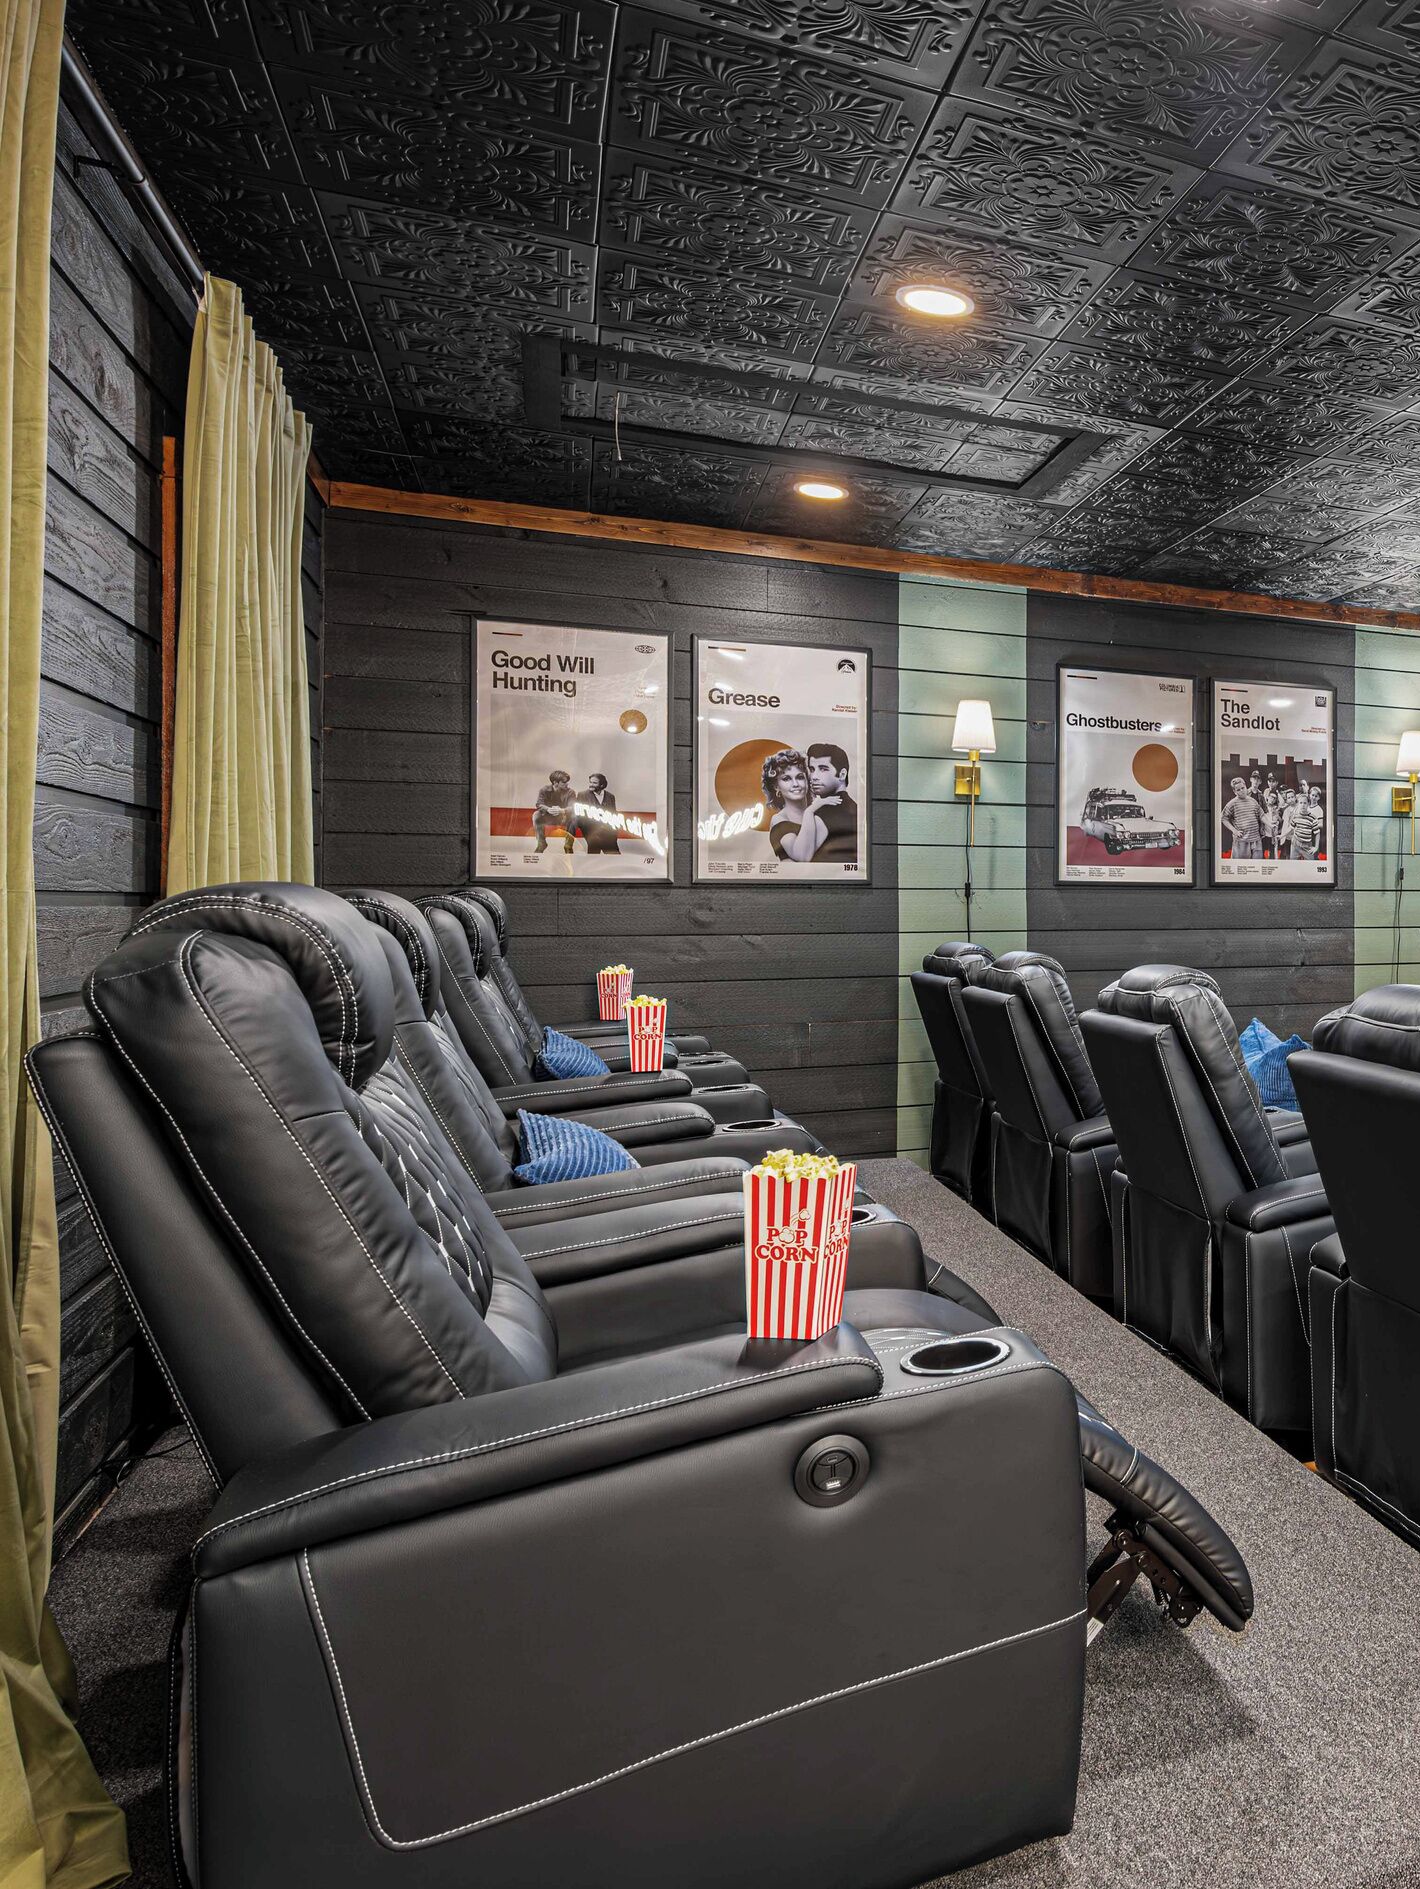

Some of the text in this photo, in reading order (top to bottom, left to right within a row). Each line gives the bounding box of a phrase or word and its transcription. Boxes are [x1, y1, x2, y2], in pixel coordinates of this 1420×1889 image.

[491, 650, 595, 674] Good Will
[492, 671, 577, 698] Hunting
[708, 688, 780, 708] Grease
[1220, 699, 1250, 714] The
[1066, 713, 1162, 732] Ghostbusters
[1221, 713, 1280, 731] Sandlot
[756, 1244, 818, 1262] CORN
[824, 1236, 848, 1259] CORN
